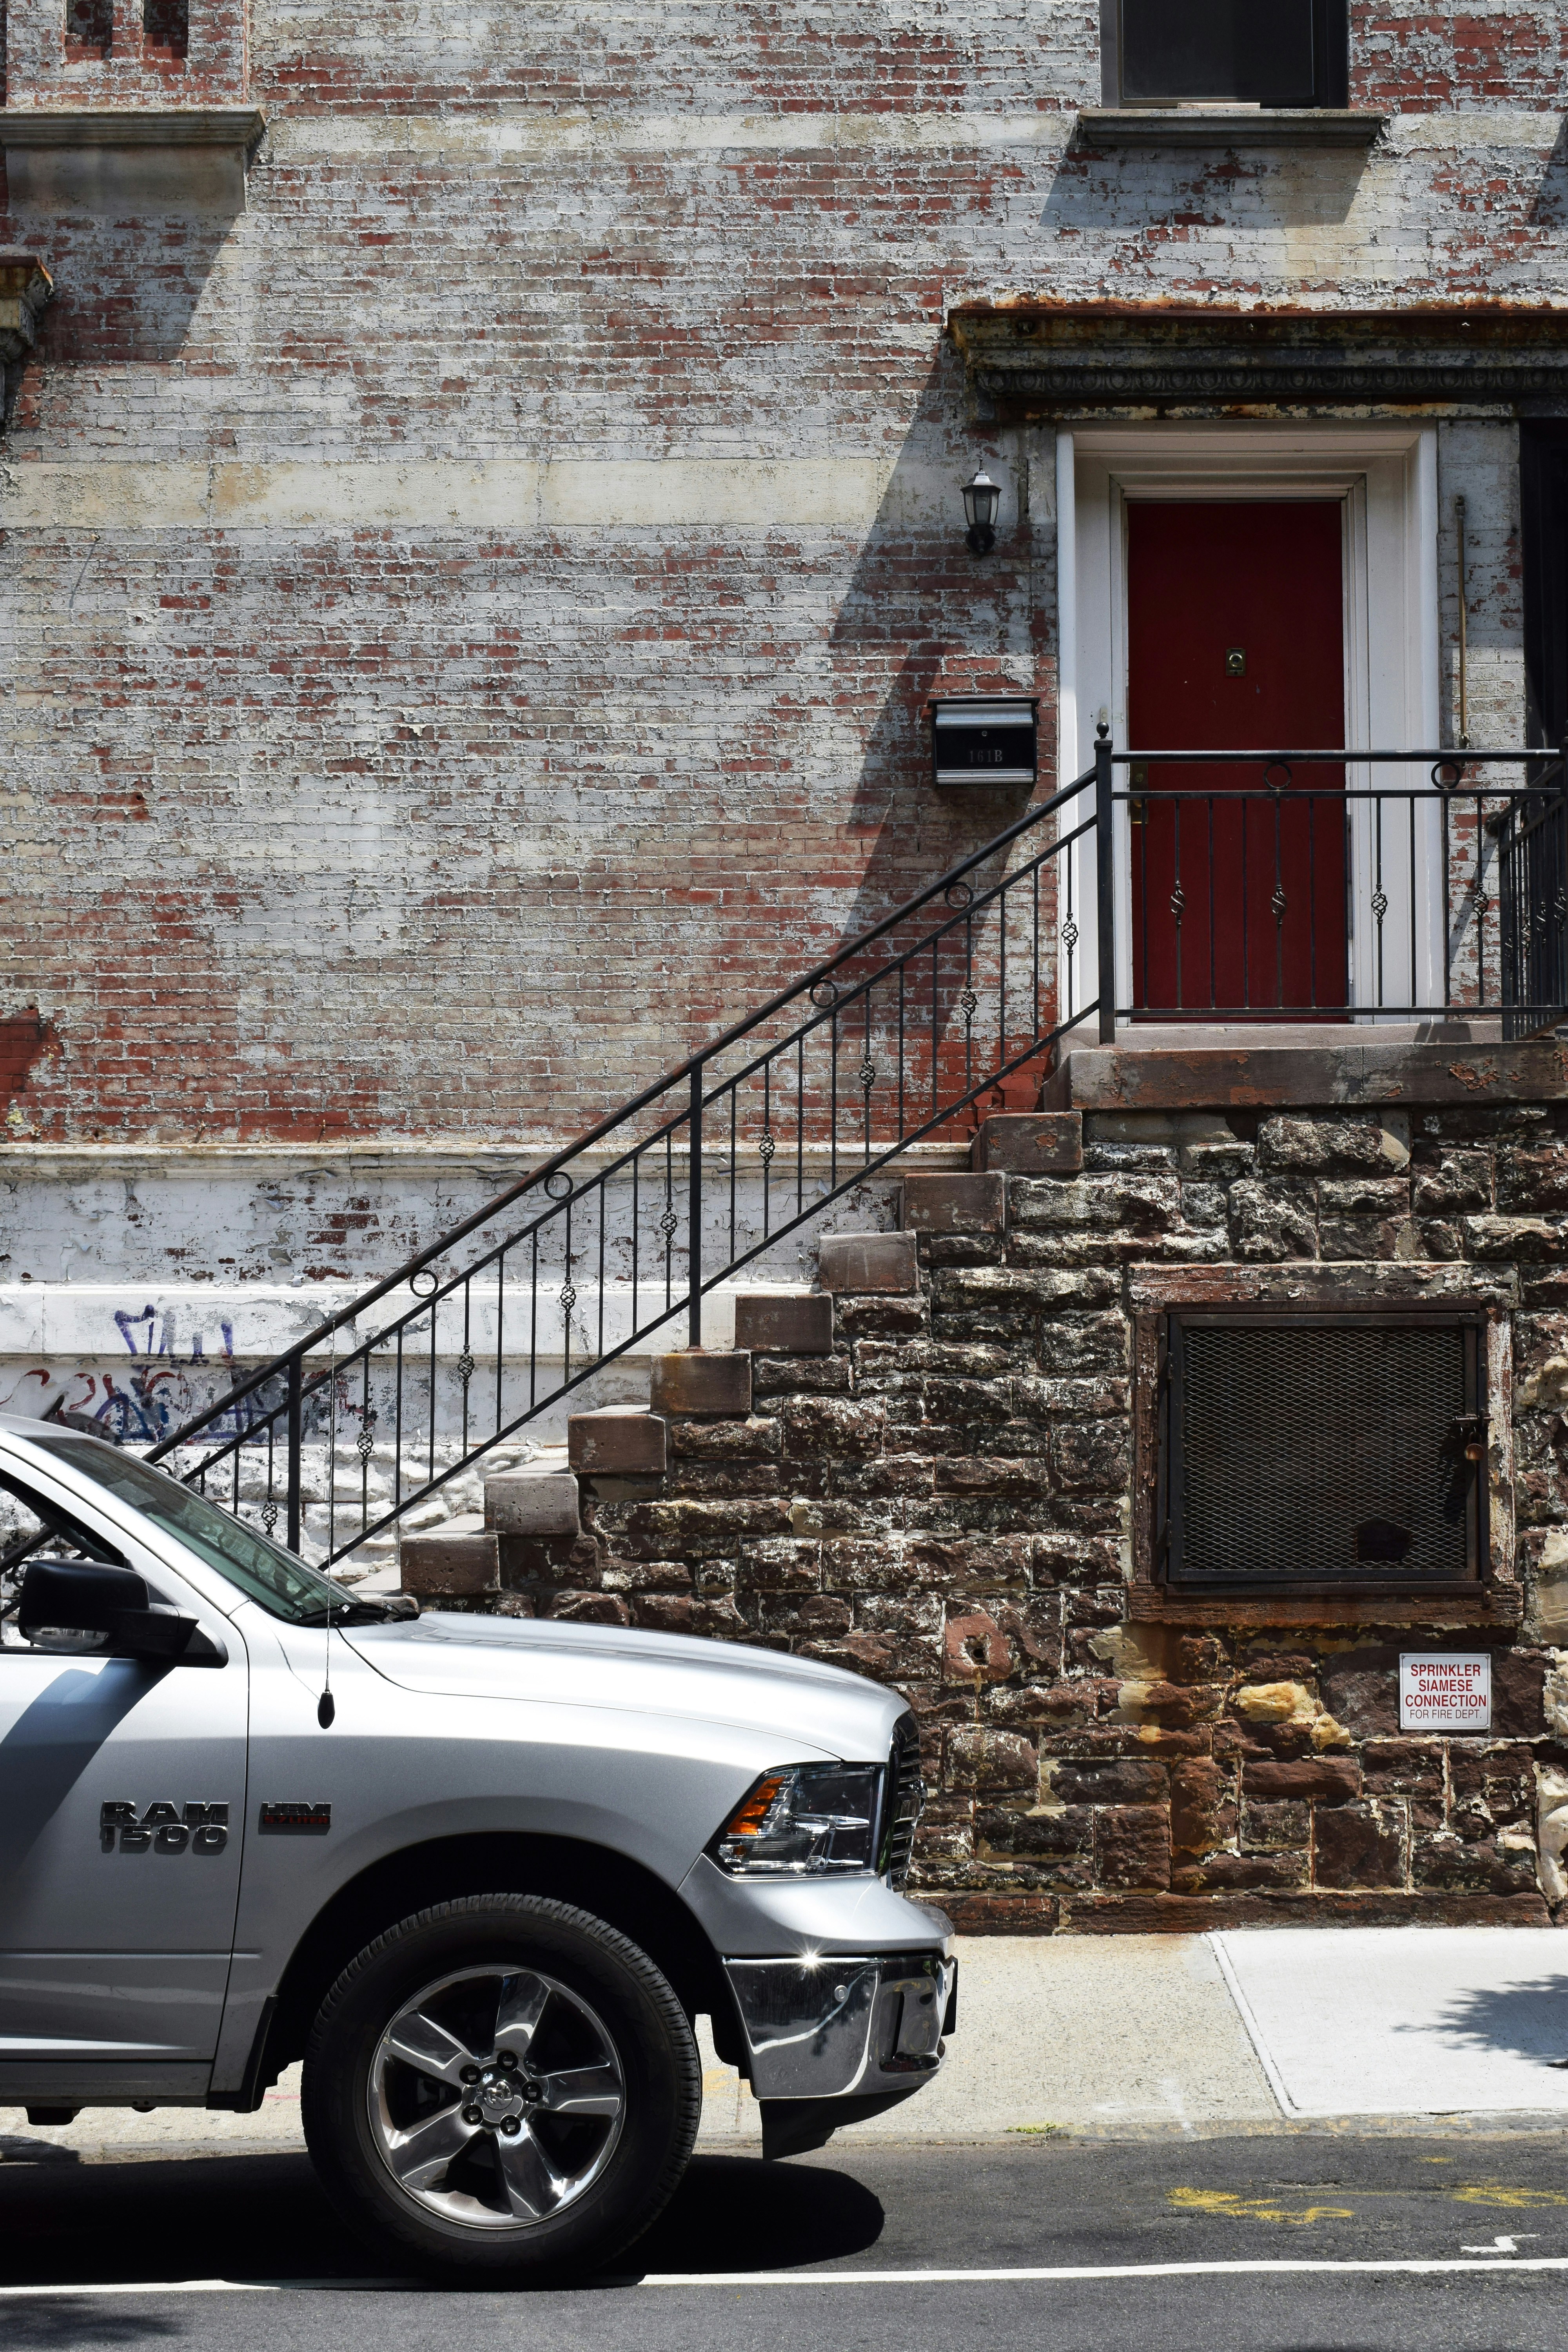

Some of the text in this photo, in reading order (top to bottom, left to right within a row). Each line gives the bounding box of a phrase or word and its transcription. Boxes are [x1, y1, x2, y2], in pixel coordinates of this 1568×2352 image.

[969, 750, 1002, 762] 161B
[1411, 1664, 1481, 1676] SPRINKLER
[1419, 1679, 1473, 1691] SIAMESE
[1405, 1695, 1486, 1707] CONNECTION
[1410, 1710, 1482, 1719] FOR FIRE DEPT.
[103, 1800, 229, 1821] RAM
[262, 1801, 332, 1815] HEMI
[264, 1815, 328, 1824] 5.7 LITER
[103, 1824, 228, 1843] 1500
[505, 1927, 664, 2118] GOODYEAR
[337, 2145, 546, 2269] WRANGLER
